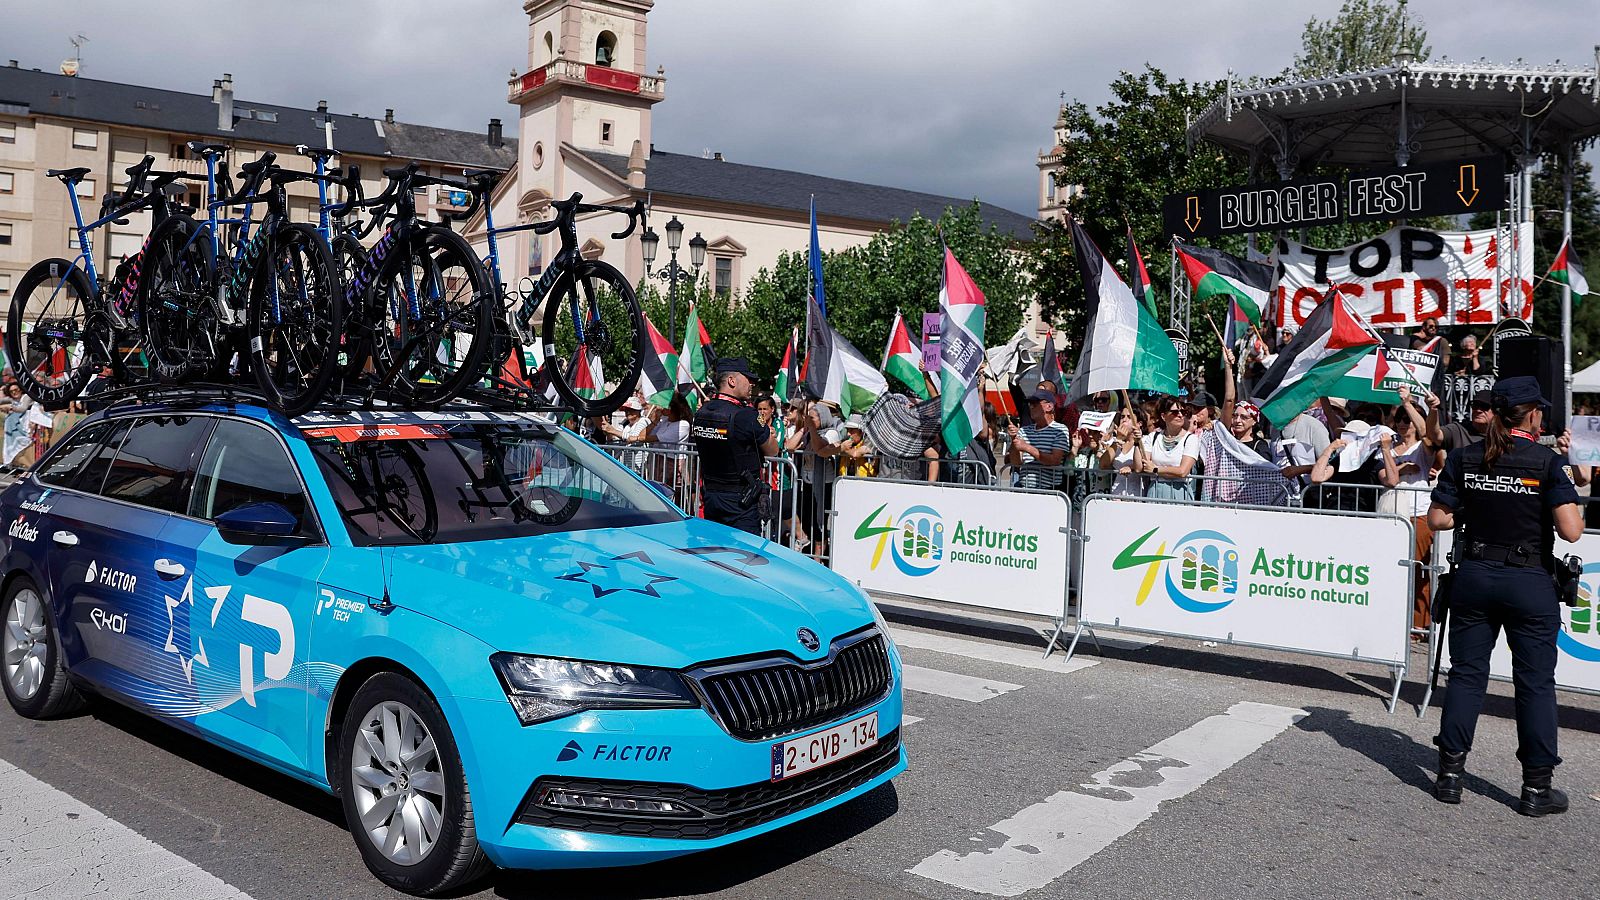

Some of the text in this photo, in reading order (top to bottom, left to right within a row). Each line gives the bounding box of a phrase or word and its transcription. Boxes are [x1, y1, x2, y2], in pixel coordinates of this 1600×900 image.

[1220, 172, 1426, 229] BURGER FEST
[1386, 350, 1436, 366] PALESTINA
[356, 428, 400, 438] EQUIPOS
[694, 425, 718, 434] POLICIA
[694, 431, 728, 440] NACIONAL
[1464, 473, 1523, 486] POLICIA
[1464, 481, 1540, 495] NACIONAL
[952, 519, 1038, 553] Asturias
[950, 550, 1037, 570] paraíso natural
[1250, 547, 1370, 586] Asturias
[99, 567, 137, 593] FACTOR
[1248, 581, 1369, 606] paraíso natural
[335, 598, 366, 613] PREMIER
[332, 609, 351, 622] TECH
[593, 744, 672, 762] FACTOR
[774, 718, 876, 776] B 2-CVB-134
